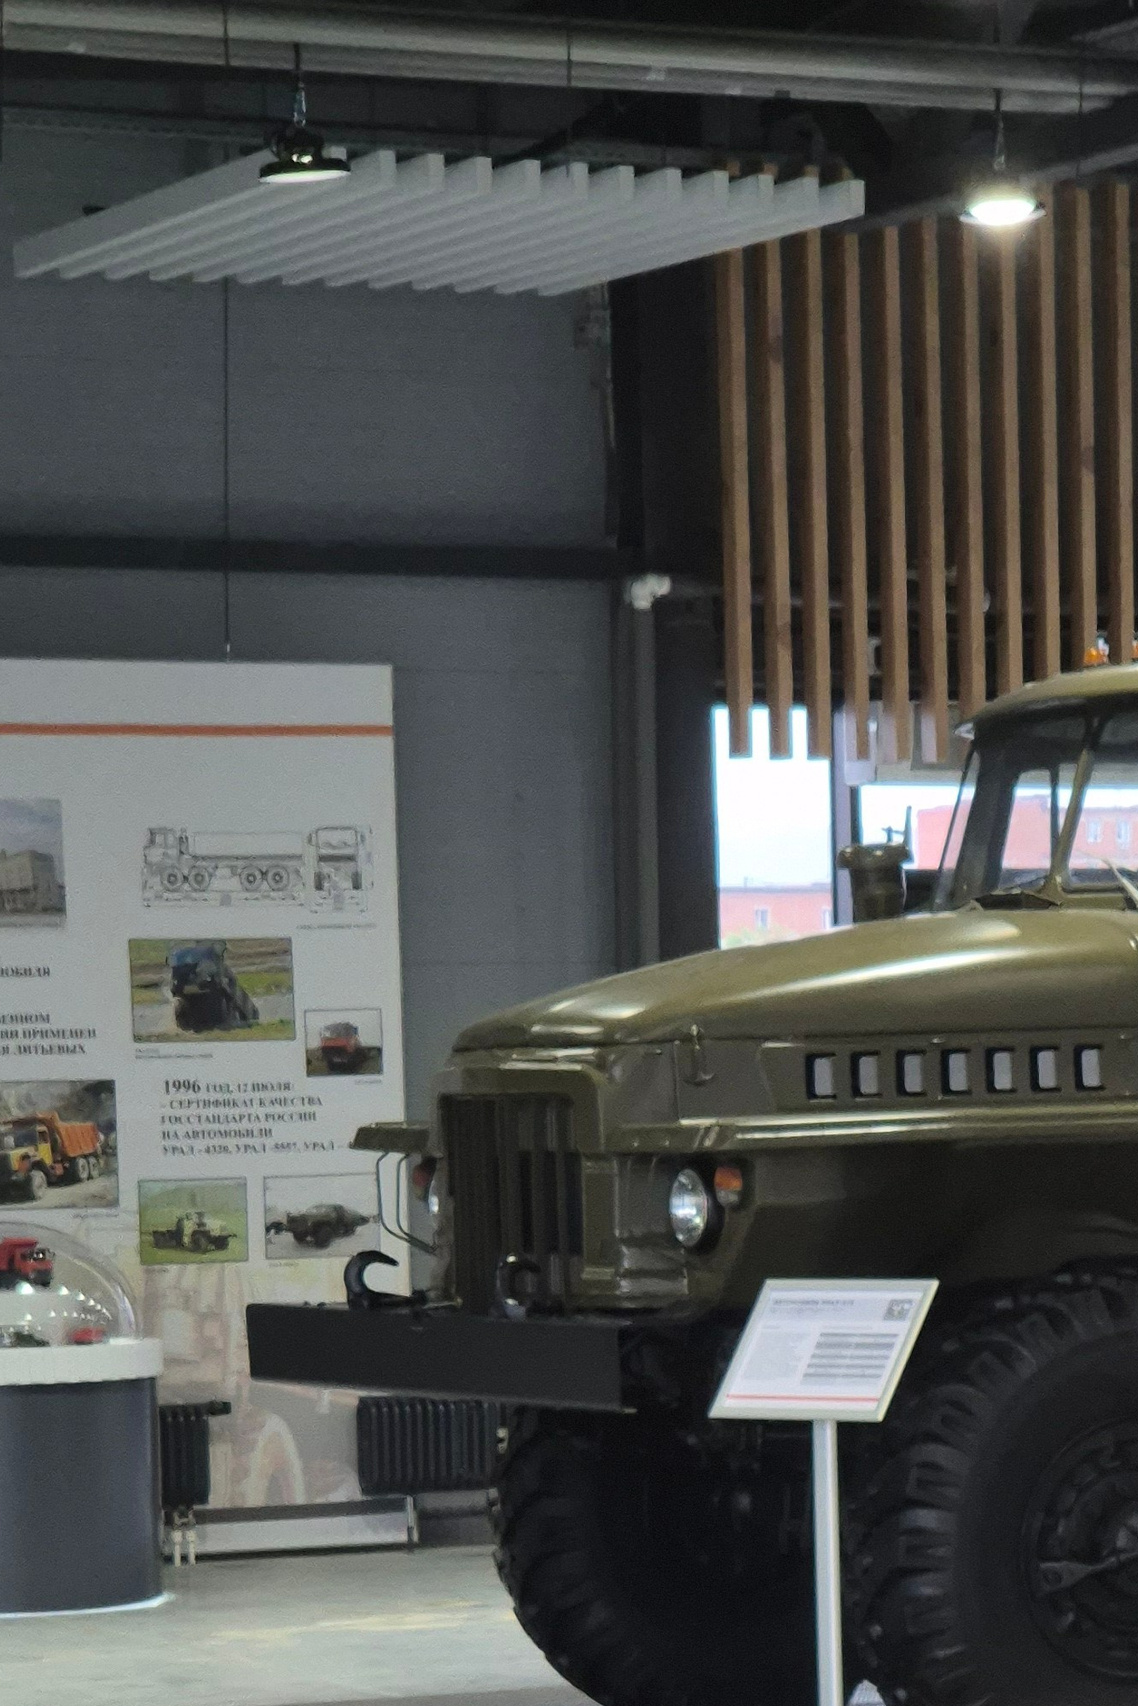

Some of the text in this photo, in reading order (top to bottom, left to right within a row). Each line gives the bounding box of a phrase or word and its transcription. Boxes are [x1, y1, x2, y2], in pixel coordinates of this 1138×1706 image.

[164, 1079, 202, 1096] 1996
[169, 1097, 254, 1110] СЕРТИФИКАТ
[258, 1096, 324, 1108] КАЧЕСТВА
[161, 1111, 317, 1126] ГОССТАНДАРТА РОССИИ
[161, 1128, 273, 1141] НА АВТОМОБИЛИ
